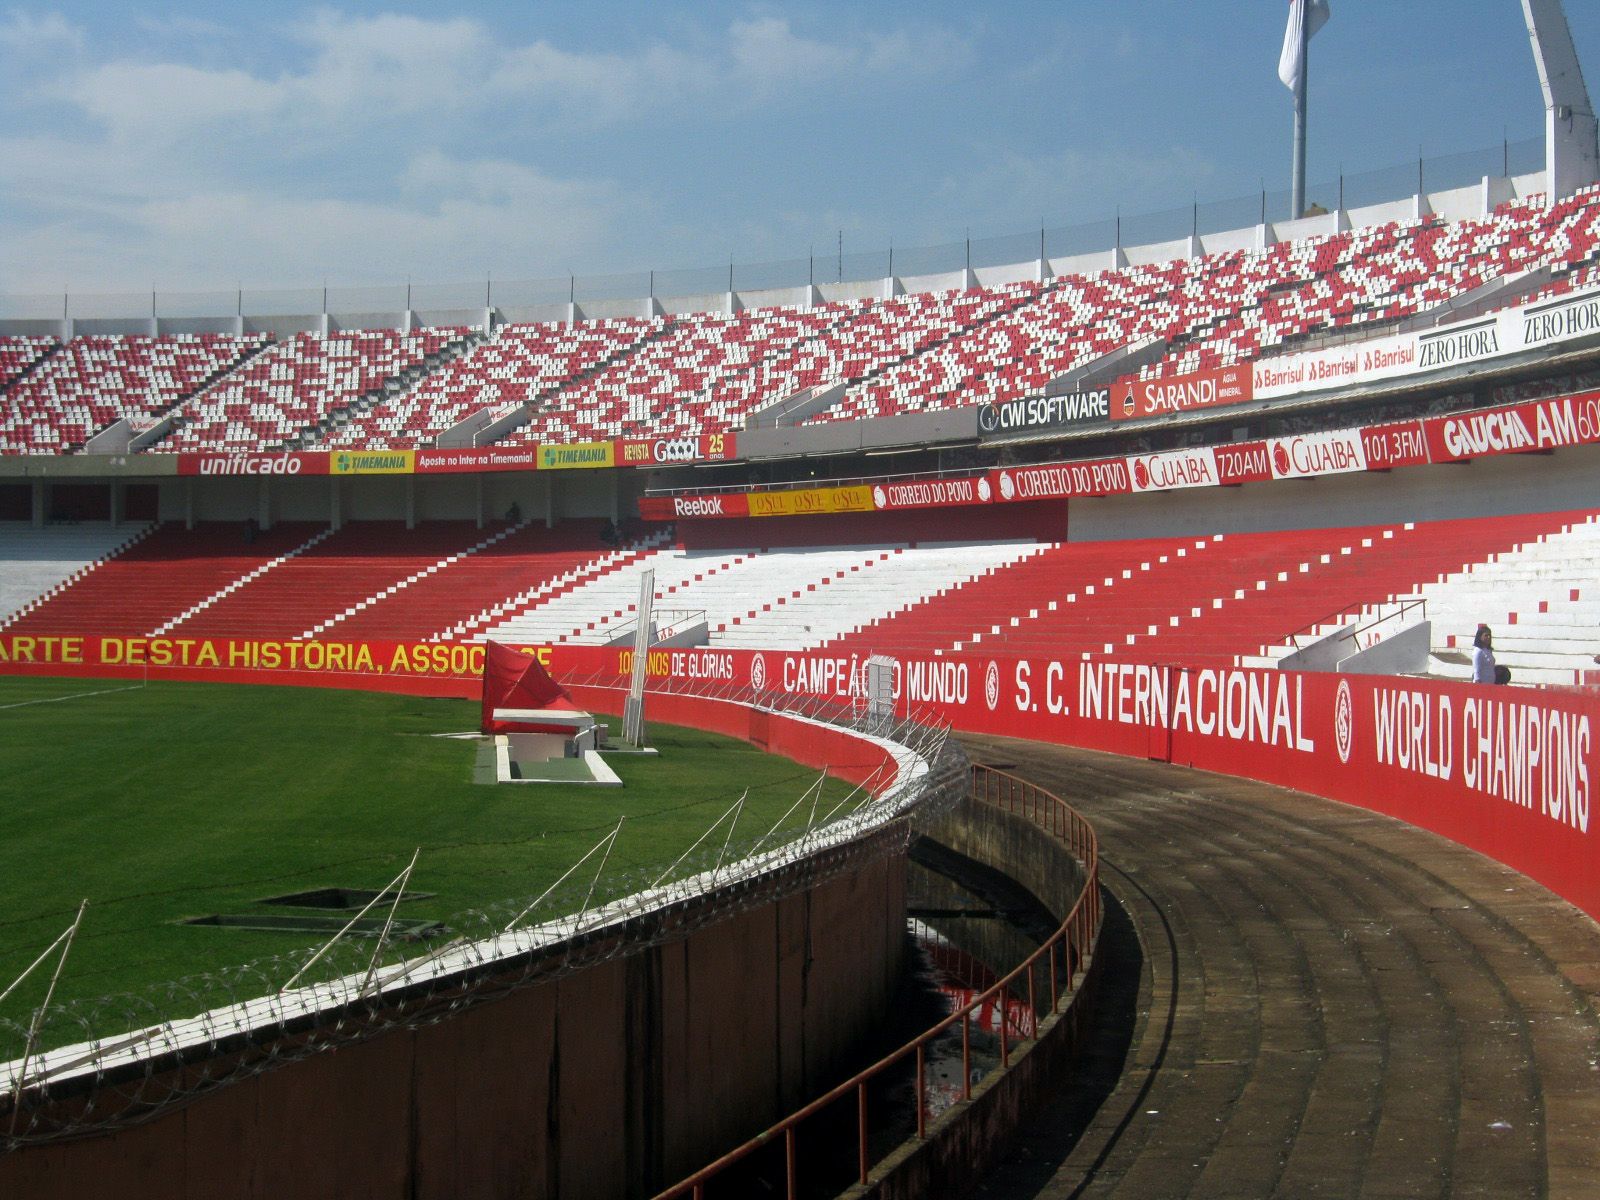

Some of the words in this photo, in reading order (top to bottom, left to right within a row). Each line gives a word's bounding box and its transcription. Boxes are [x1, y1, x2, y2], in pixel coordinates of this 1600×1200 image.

[1524, 311, 1563, 345] ZERO
[1374, 341, 1415, 369] Banrisul
[1419, 337, 1456, 368] ZERO
[1458, 328, 1499, 360] HORA
[1264, 362, 1304, 388] Banrisul
[1318, 353, 1359, 379] Banrisul
[1145, 378, 1217, 413] SARANDI
[1218, 386, 1242, 398] MINERAL
[1000, 401, 1026, 428] CWI
[1027, 390, 1108, 424] SOFTWARE
[1536, 399, 1579, 448] AM
[1578, 398, 1600, 440] 60
[419, 456, 446, 469] Aposte
[447, 458, 458, 466] no
[459, 455, 478, 466] Inter
[479, 456, 488, 465] na
[489, 452, 533, 465] Timemania!
[557, 447, 606, 463] TIMEMANIA
[624, 444, 650, 461] REVISTA
[709, 434, 724, 453] 25
[1364, 430, 1424, 464] 101,3FM
[200, 453, 301, 475] unificado
[352, 455, 406, 469] TIMEMANIA
[1217, 449, 1268, 478] 720AM
[888, 484, 932, 506] CORREIO
[931, 483, 946, 503] DO
[946, 481, 973, 502] POVO
[1016, 467, 1073, 498] CORREIO
[1074, 466, 1092, 494] DO
[1094, 462, 1128, 492] POVO
[674, 496, 724, 516] Reebok
[101, 638, 220, 666] DESTA
[229, 640, 383, 675] HISTÓRIA,
[671, 652, 686, 677] DE
[688, 650, 733, 679] GLÓRIAS
[907, 660, 968, 704] MUNDO
[1015, 660, 1037, 713] S.
[1046, 661, 1069, 716] C.
[1079, 662, 1315, 753] INTERNACIONAL
[1374, 687, 1452, 781] WORLD
[1463, 697, 1590, 834] CHAMPIONS
